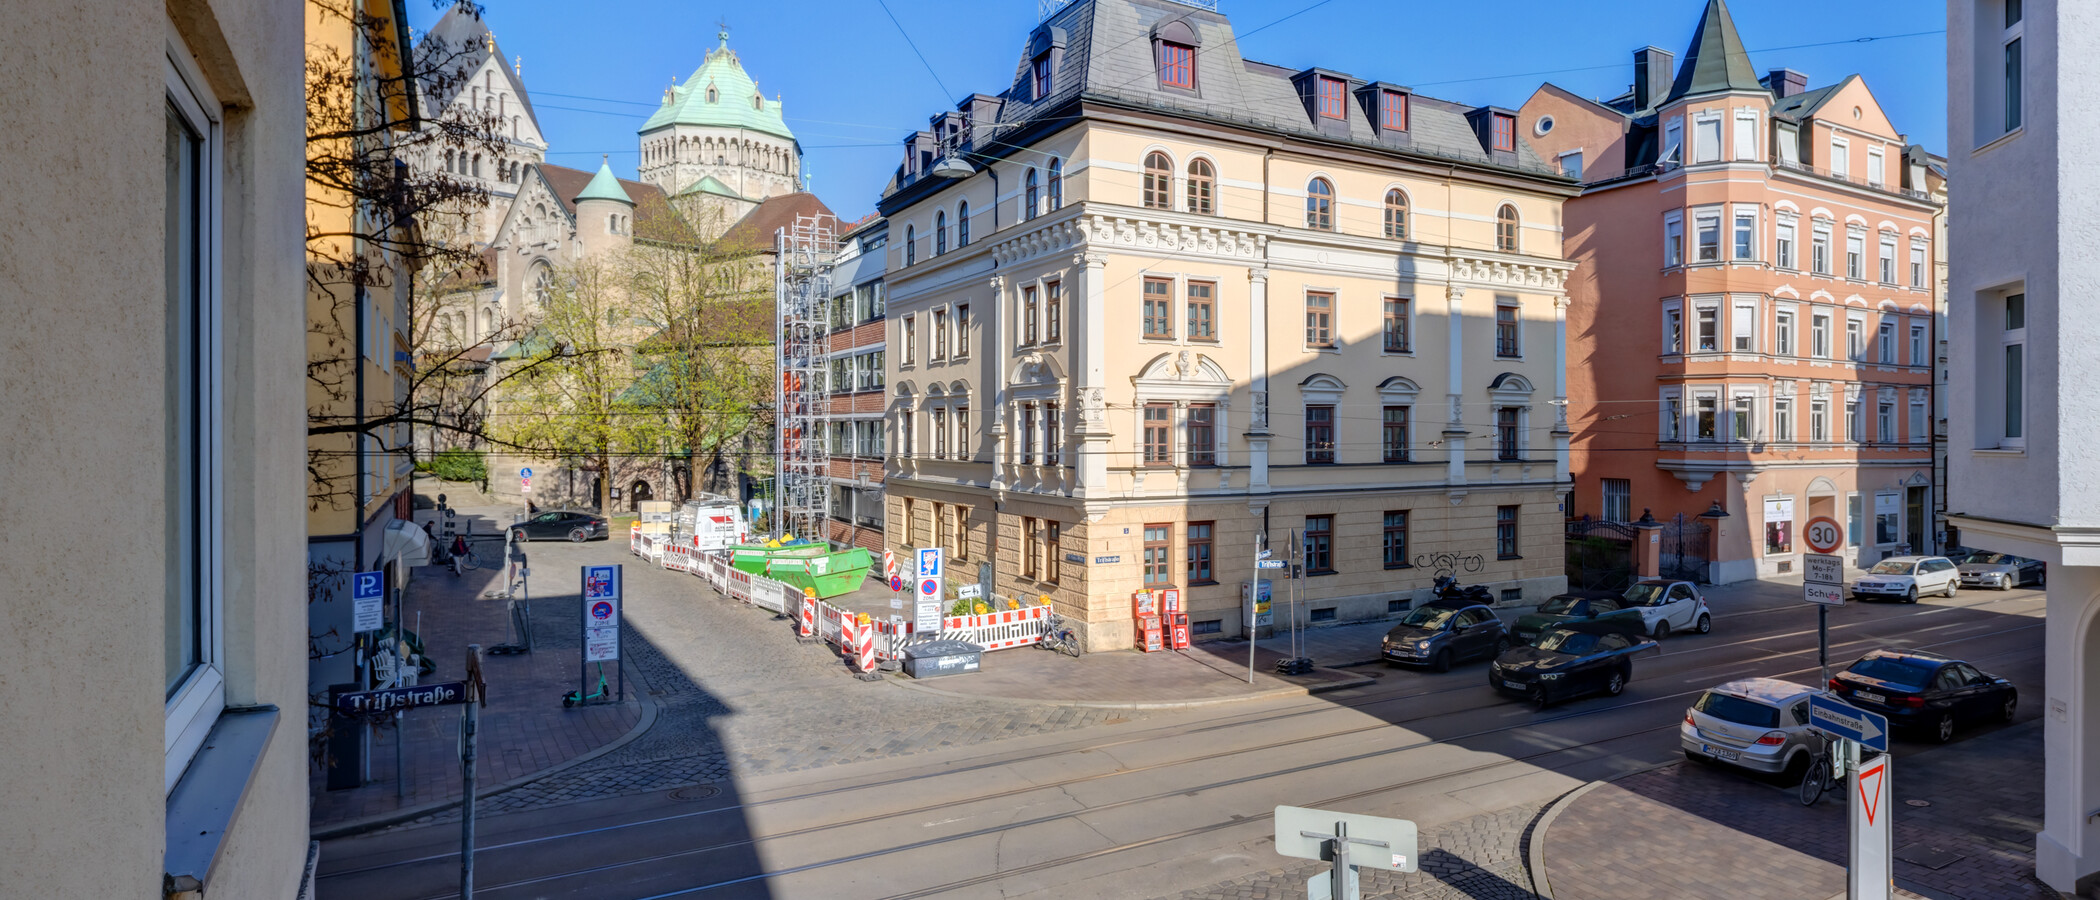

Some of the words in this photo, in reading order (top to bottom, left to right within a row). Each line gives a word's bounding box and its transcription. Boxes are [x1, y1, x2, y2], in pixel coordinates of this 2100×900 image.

[1812, 527, 1834, 544] 30
[1807, 557, 1841, 567] werktags
[1812, 565, 1835, 573] Mo-Fr
[360, 575, 376, 596] P
[350, 686, 455, 711] Triftstraße
[1813, 707, 1864, 731] Einbahnstraße
